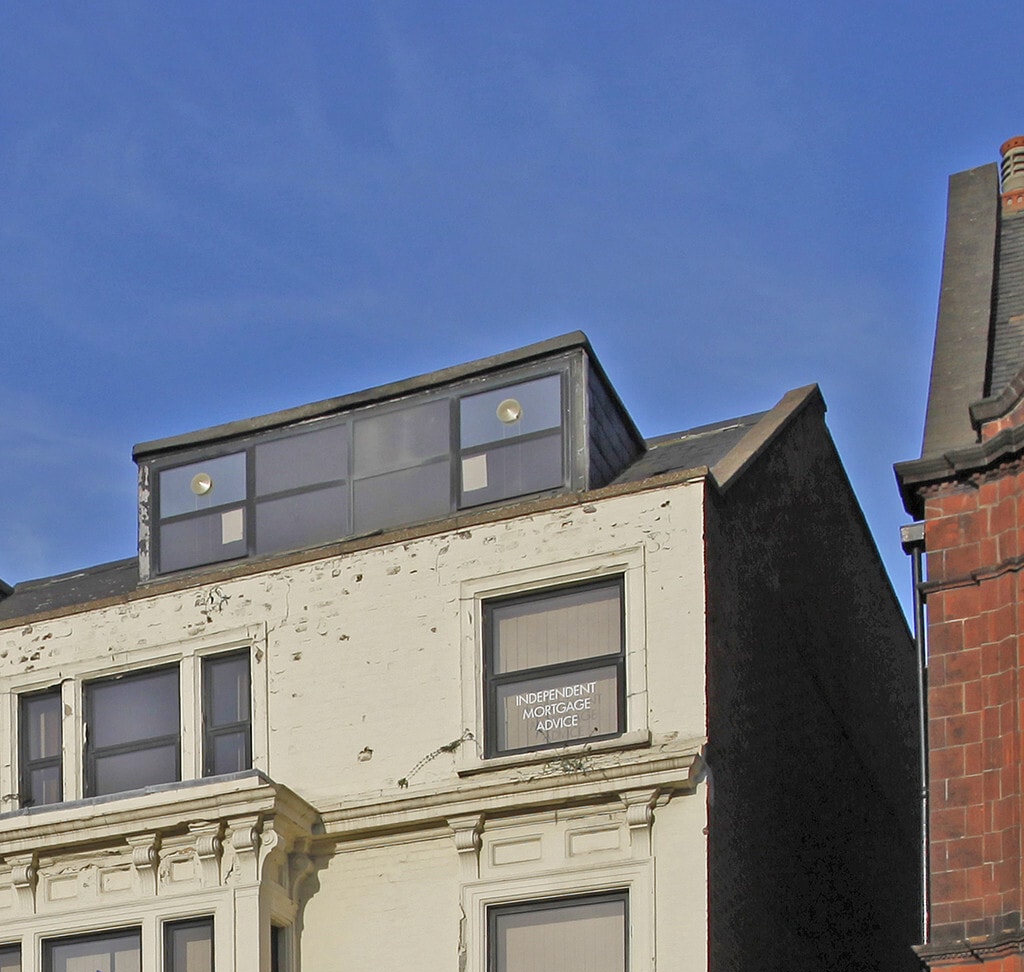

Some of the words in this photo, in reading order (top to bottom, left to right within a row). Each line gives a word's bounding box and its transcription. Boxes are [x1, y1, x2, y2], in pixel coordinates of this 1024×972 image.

[516, 682, 596, 706] INDEPENDENT
[523, 698, 591, 719] MORTGAGE
[536, 715, 578, 731] ADVICE
